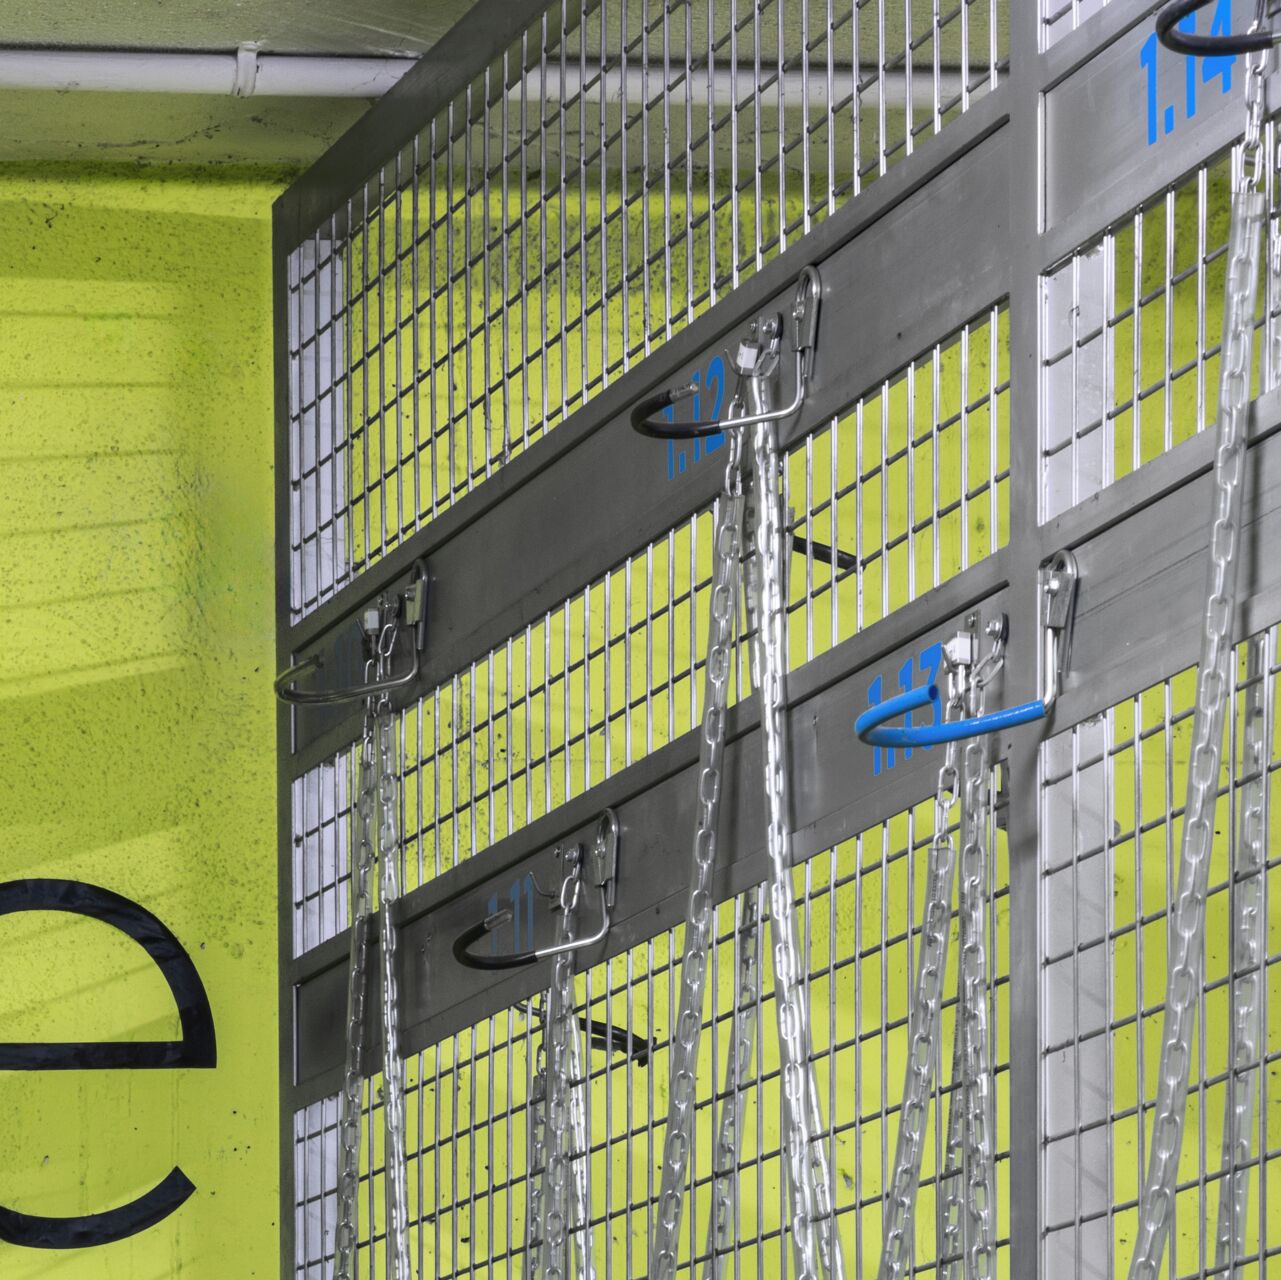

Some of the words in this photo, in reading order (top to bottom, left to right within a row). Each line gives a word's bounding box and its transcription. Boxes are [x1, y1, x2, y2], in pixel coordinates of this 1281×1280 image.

[1140, 0, 1237, 145] 1.14
[662, 355, 726, 481] 1.12
[867, 641, 943, 776] 1.13
[487, 872, 534, 972] 111
